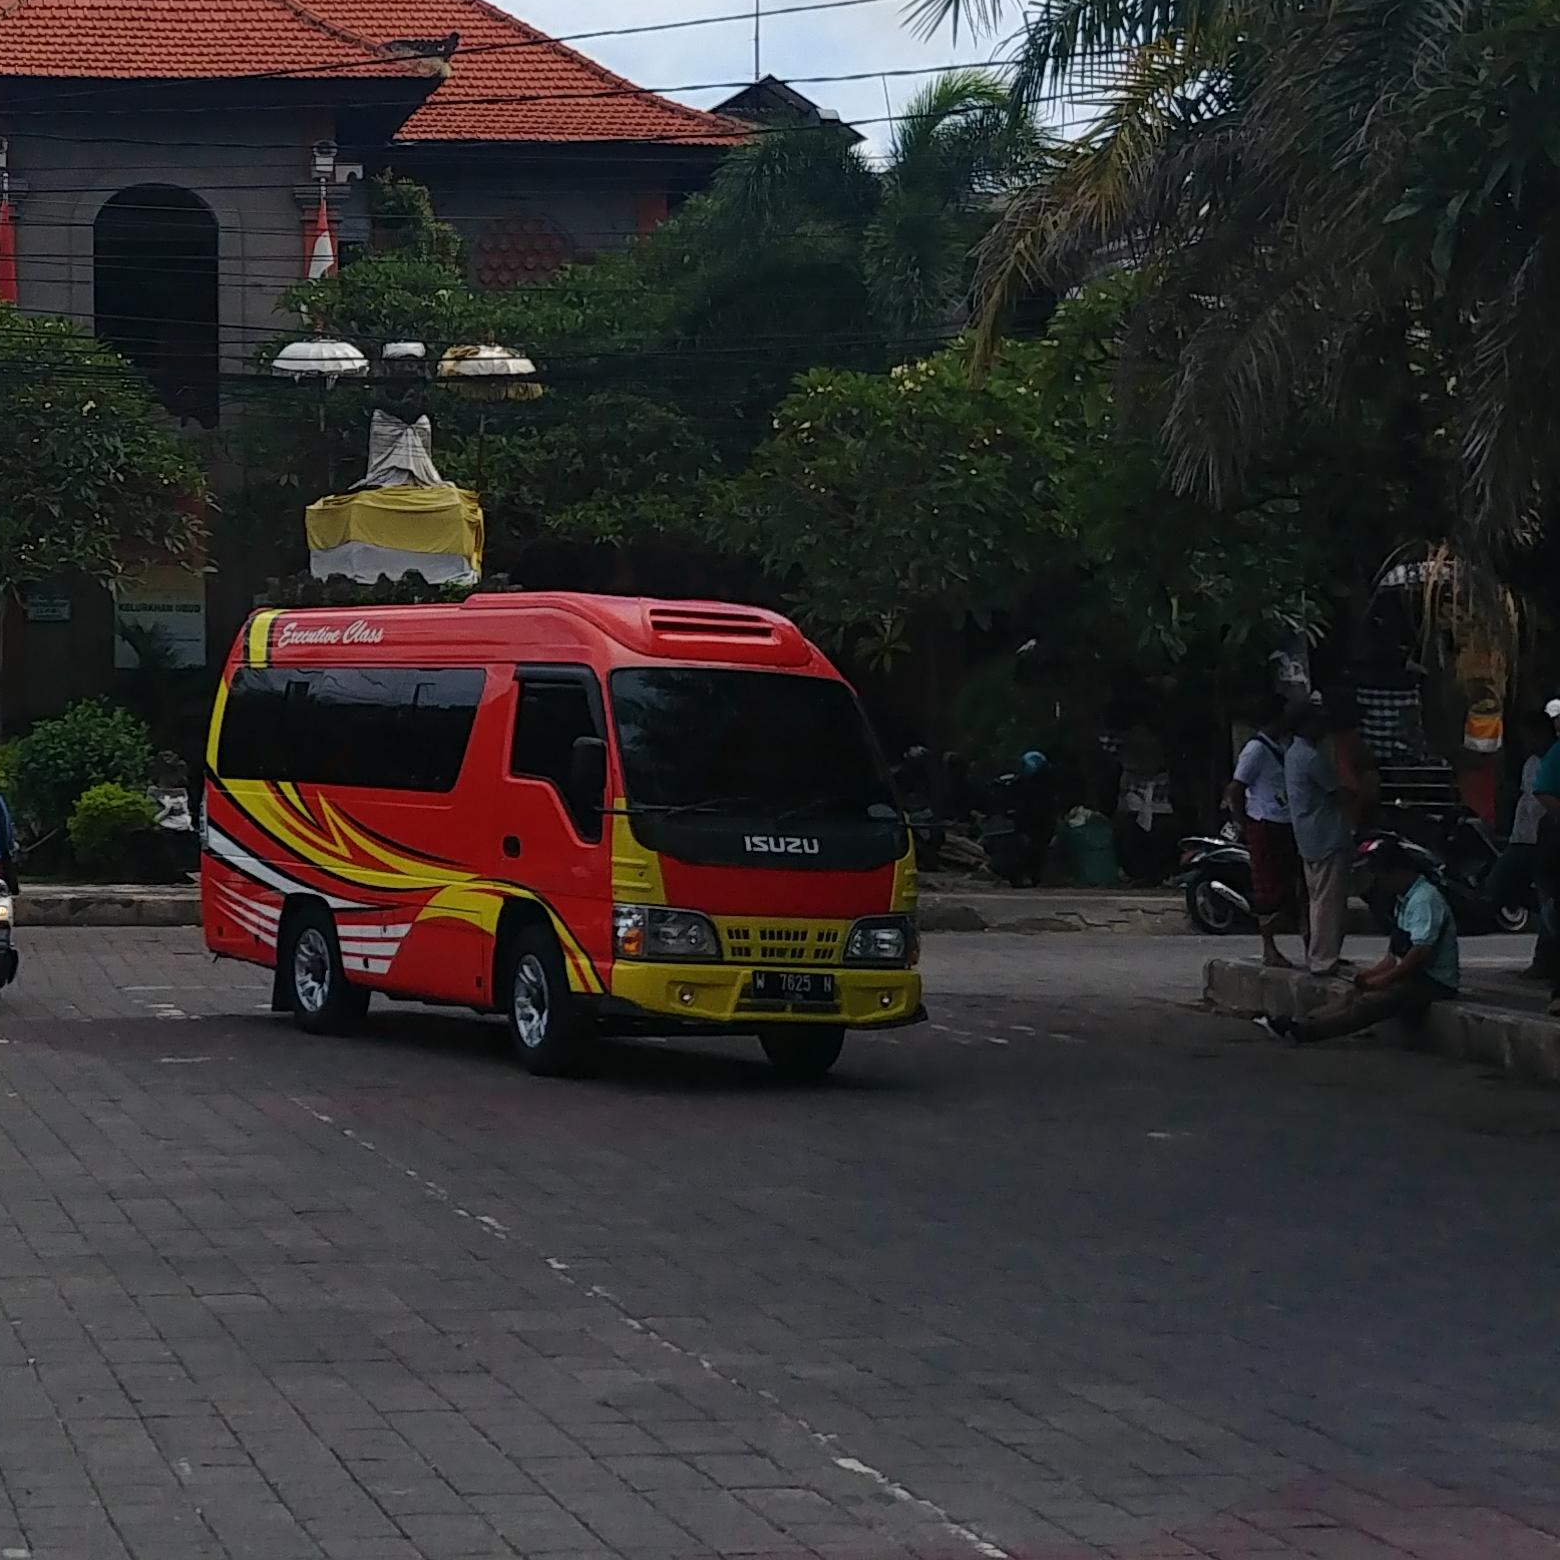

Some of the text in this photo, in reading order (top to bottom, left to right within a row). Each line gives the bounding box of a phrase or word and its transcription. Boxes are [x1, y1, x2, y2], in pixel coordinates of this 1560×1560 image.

[278, 619, 384, 648] Executive Class
[744, 835, 820, 854] ISUZU
[755, 972, 766, 990] W
